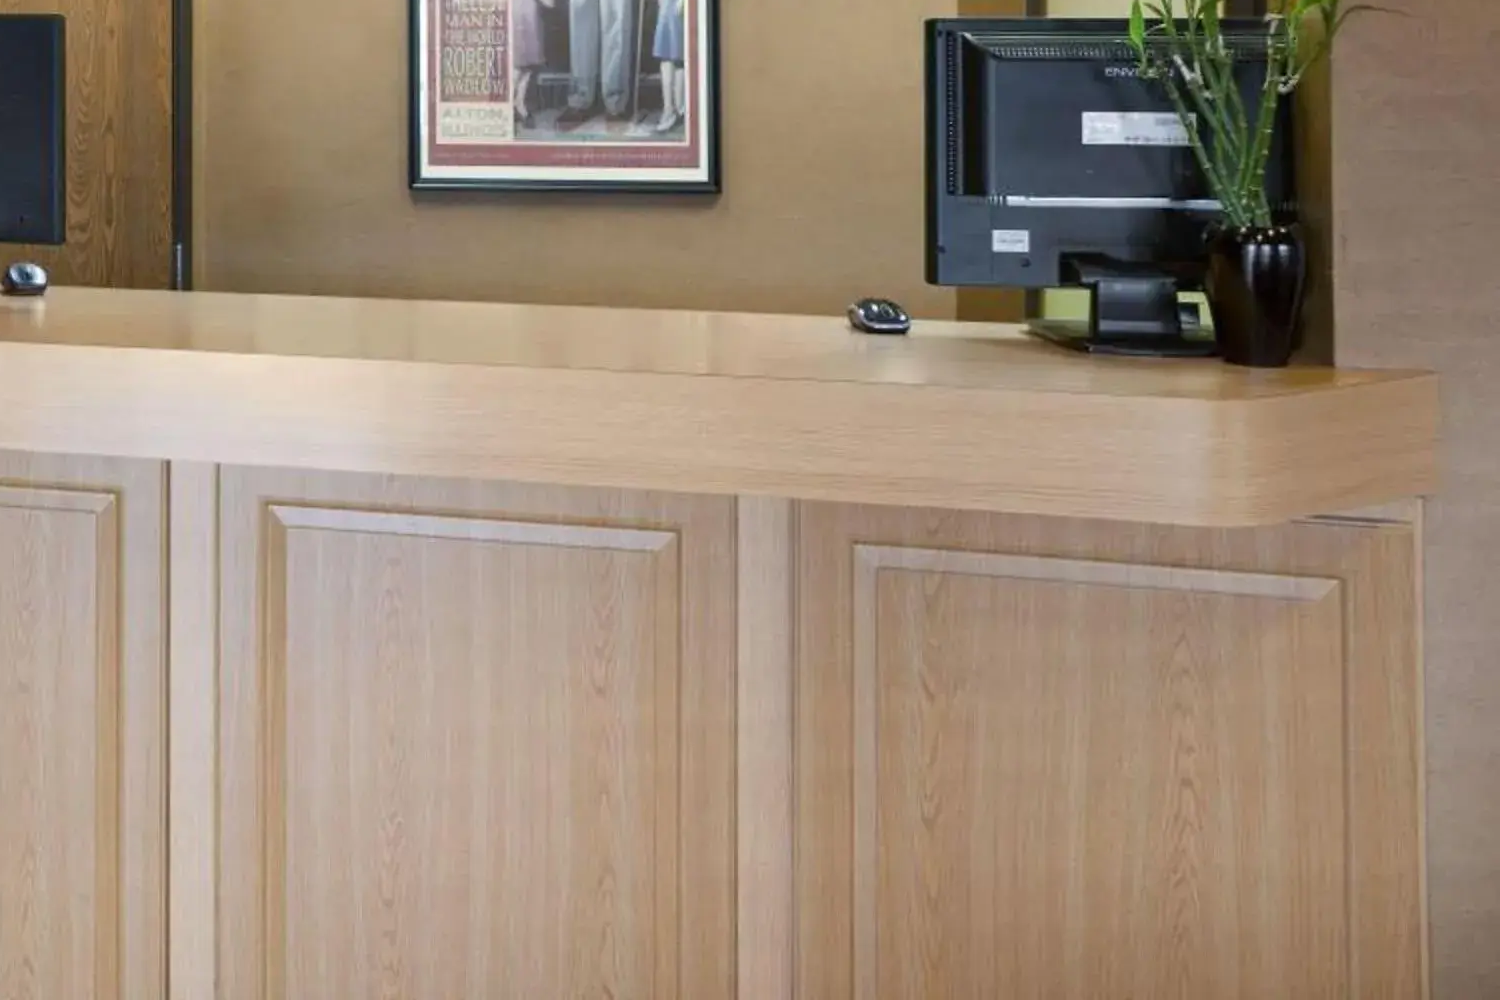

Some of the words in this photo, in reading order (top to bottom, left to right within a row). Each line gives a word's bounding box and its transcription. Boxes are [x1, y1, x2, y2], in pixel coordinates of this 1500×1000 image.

[445, 13, 483, 28] MAN
[486, 13, 504, 28] IN
[443, 46, 504, 77] ROBERT
